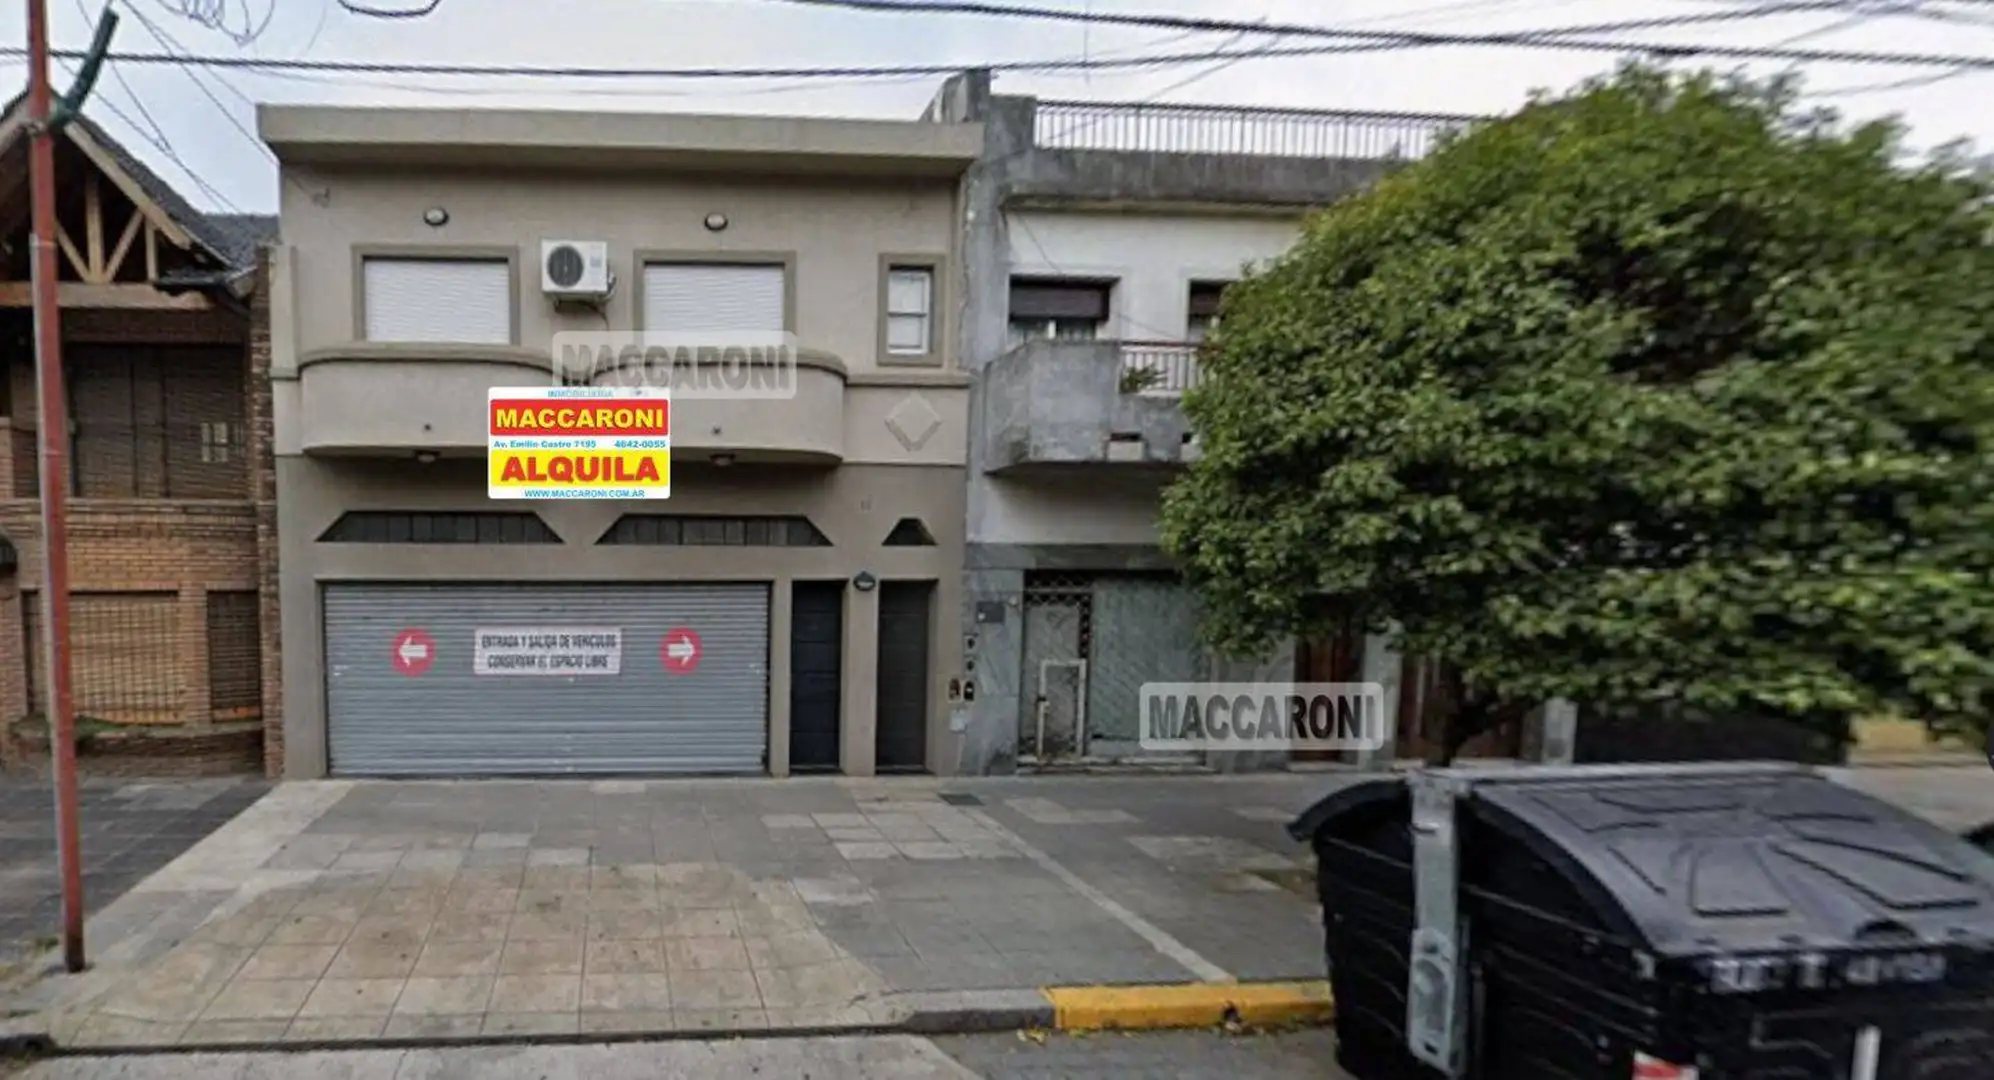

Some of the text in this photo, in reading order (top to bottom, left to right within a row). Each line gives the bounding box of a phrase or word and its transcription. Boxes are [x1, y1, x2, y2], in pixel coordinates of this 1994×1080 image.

[496, 408, 664, 428] MACCARONI
[494, 440, 507, 448] Av.
[510, 440, 538, 448] Emilio
[541, 440, 571, 448] Castro
[501, 456, 660, 483] ALQUILA
[524, 489, 645, 498] WWW.MACCARONI.COM.AR
[482, 634, 519, 648] ENTRADA
[520, 634, 527, 648] Y
[528, 634, 557, 648] SALIDA
[559, 634, 570, 648] DE
[487, 654, 535, 668] CONSERVAR
[549, 654, 583, 668] ESPACIO
[584, 654, 609, 668] LIBRE
